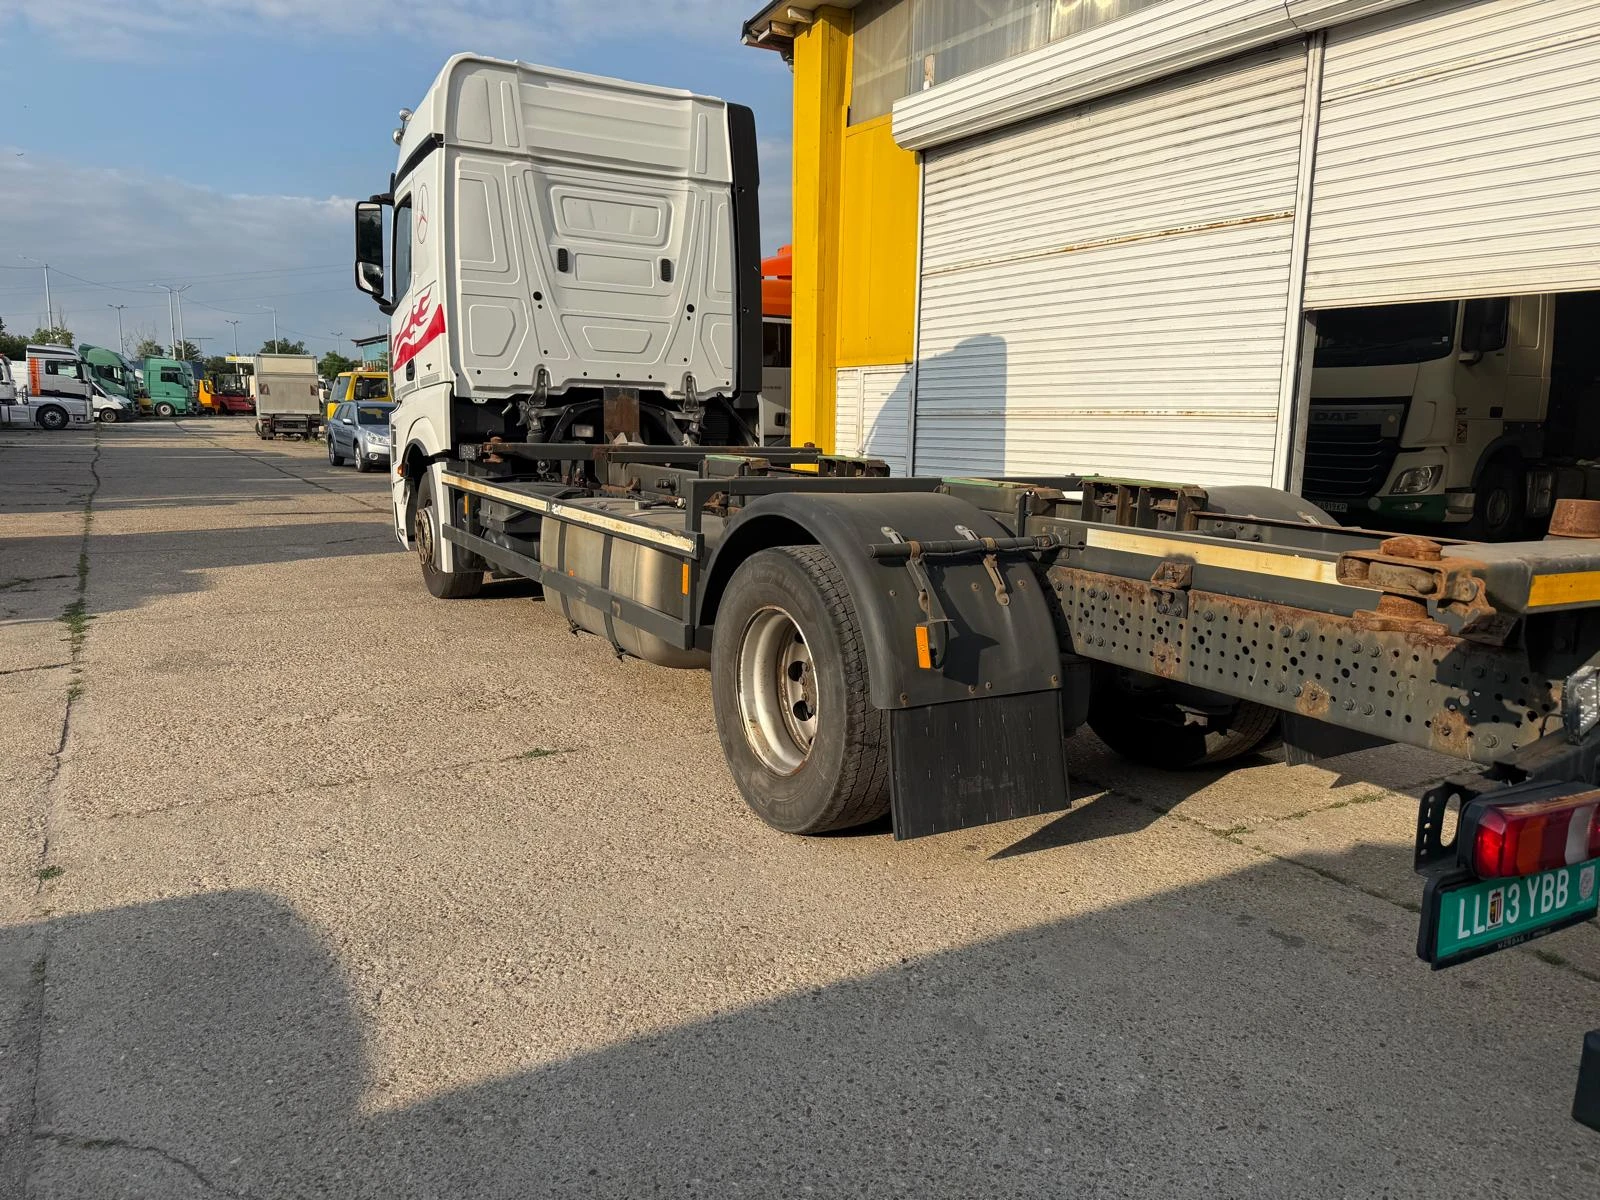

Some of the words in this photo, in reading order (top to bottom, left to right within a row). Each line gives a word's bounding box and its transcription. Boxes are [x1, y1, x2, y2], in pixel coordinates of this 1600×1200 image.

[1314, 412, 1359, 421] DAF
[1458, 894, 1485, 939] LL
[1506, 884, 1520, 924] 3
[1527, 869, 1569, 918] YBB
